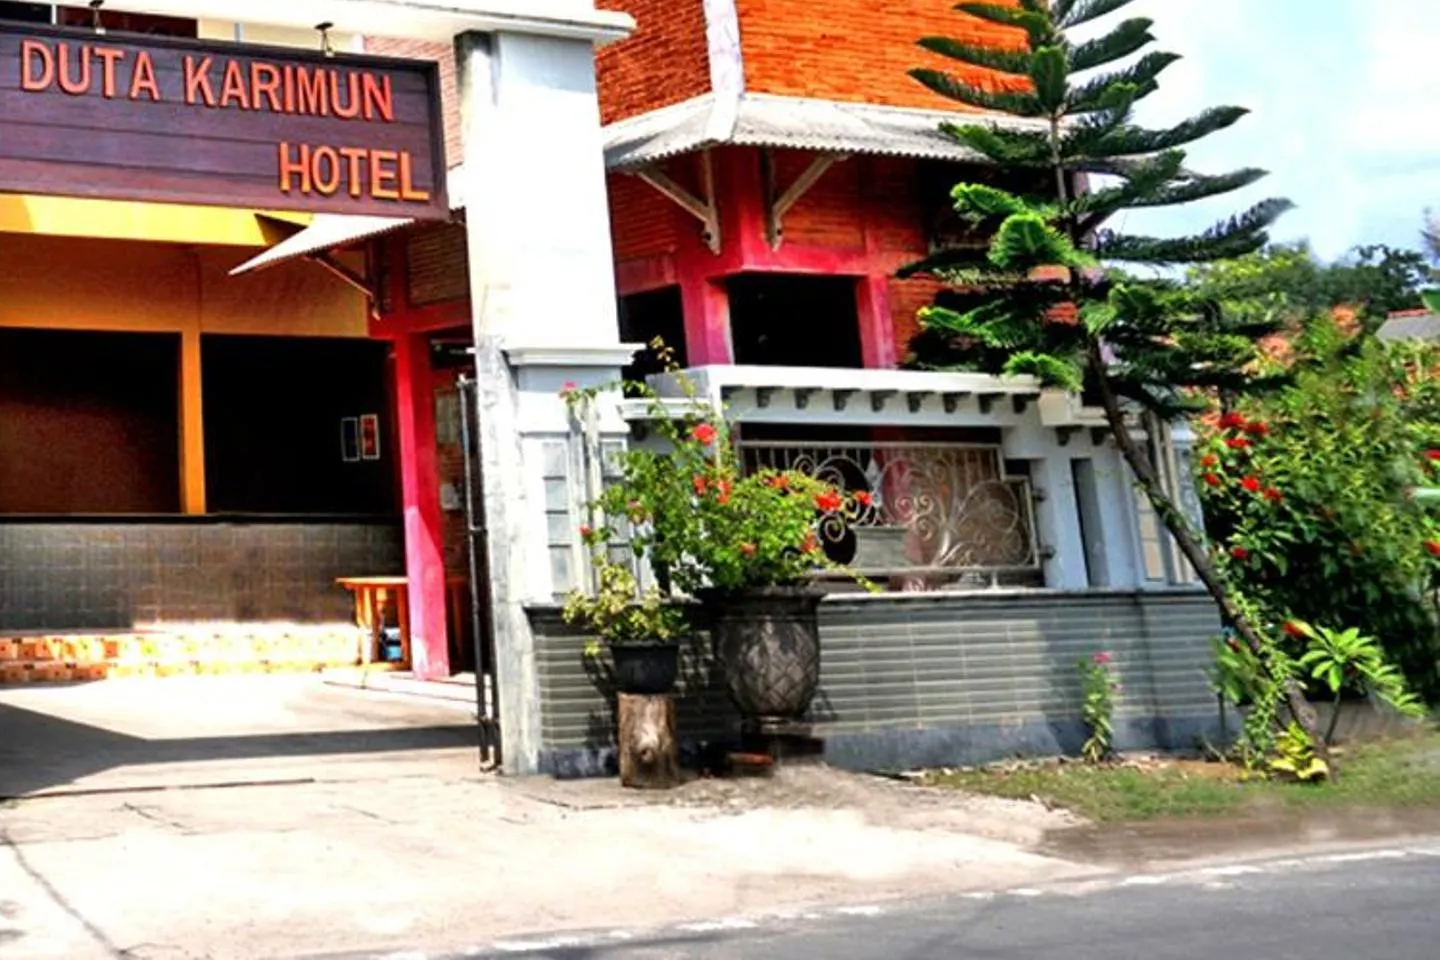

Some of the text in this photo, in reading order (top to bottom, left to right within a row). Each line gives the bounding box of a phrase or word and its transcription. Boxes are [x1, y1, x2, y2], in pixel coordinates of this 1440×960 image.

[21, 40, 394, 122] DUTA KARIMUN
[279, 141, 430, 201] HOTEL
